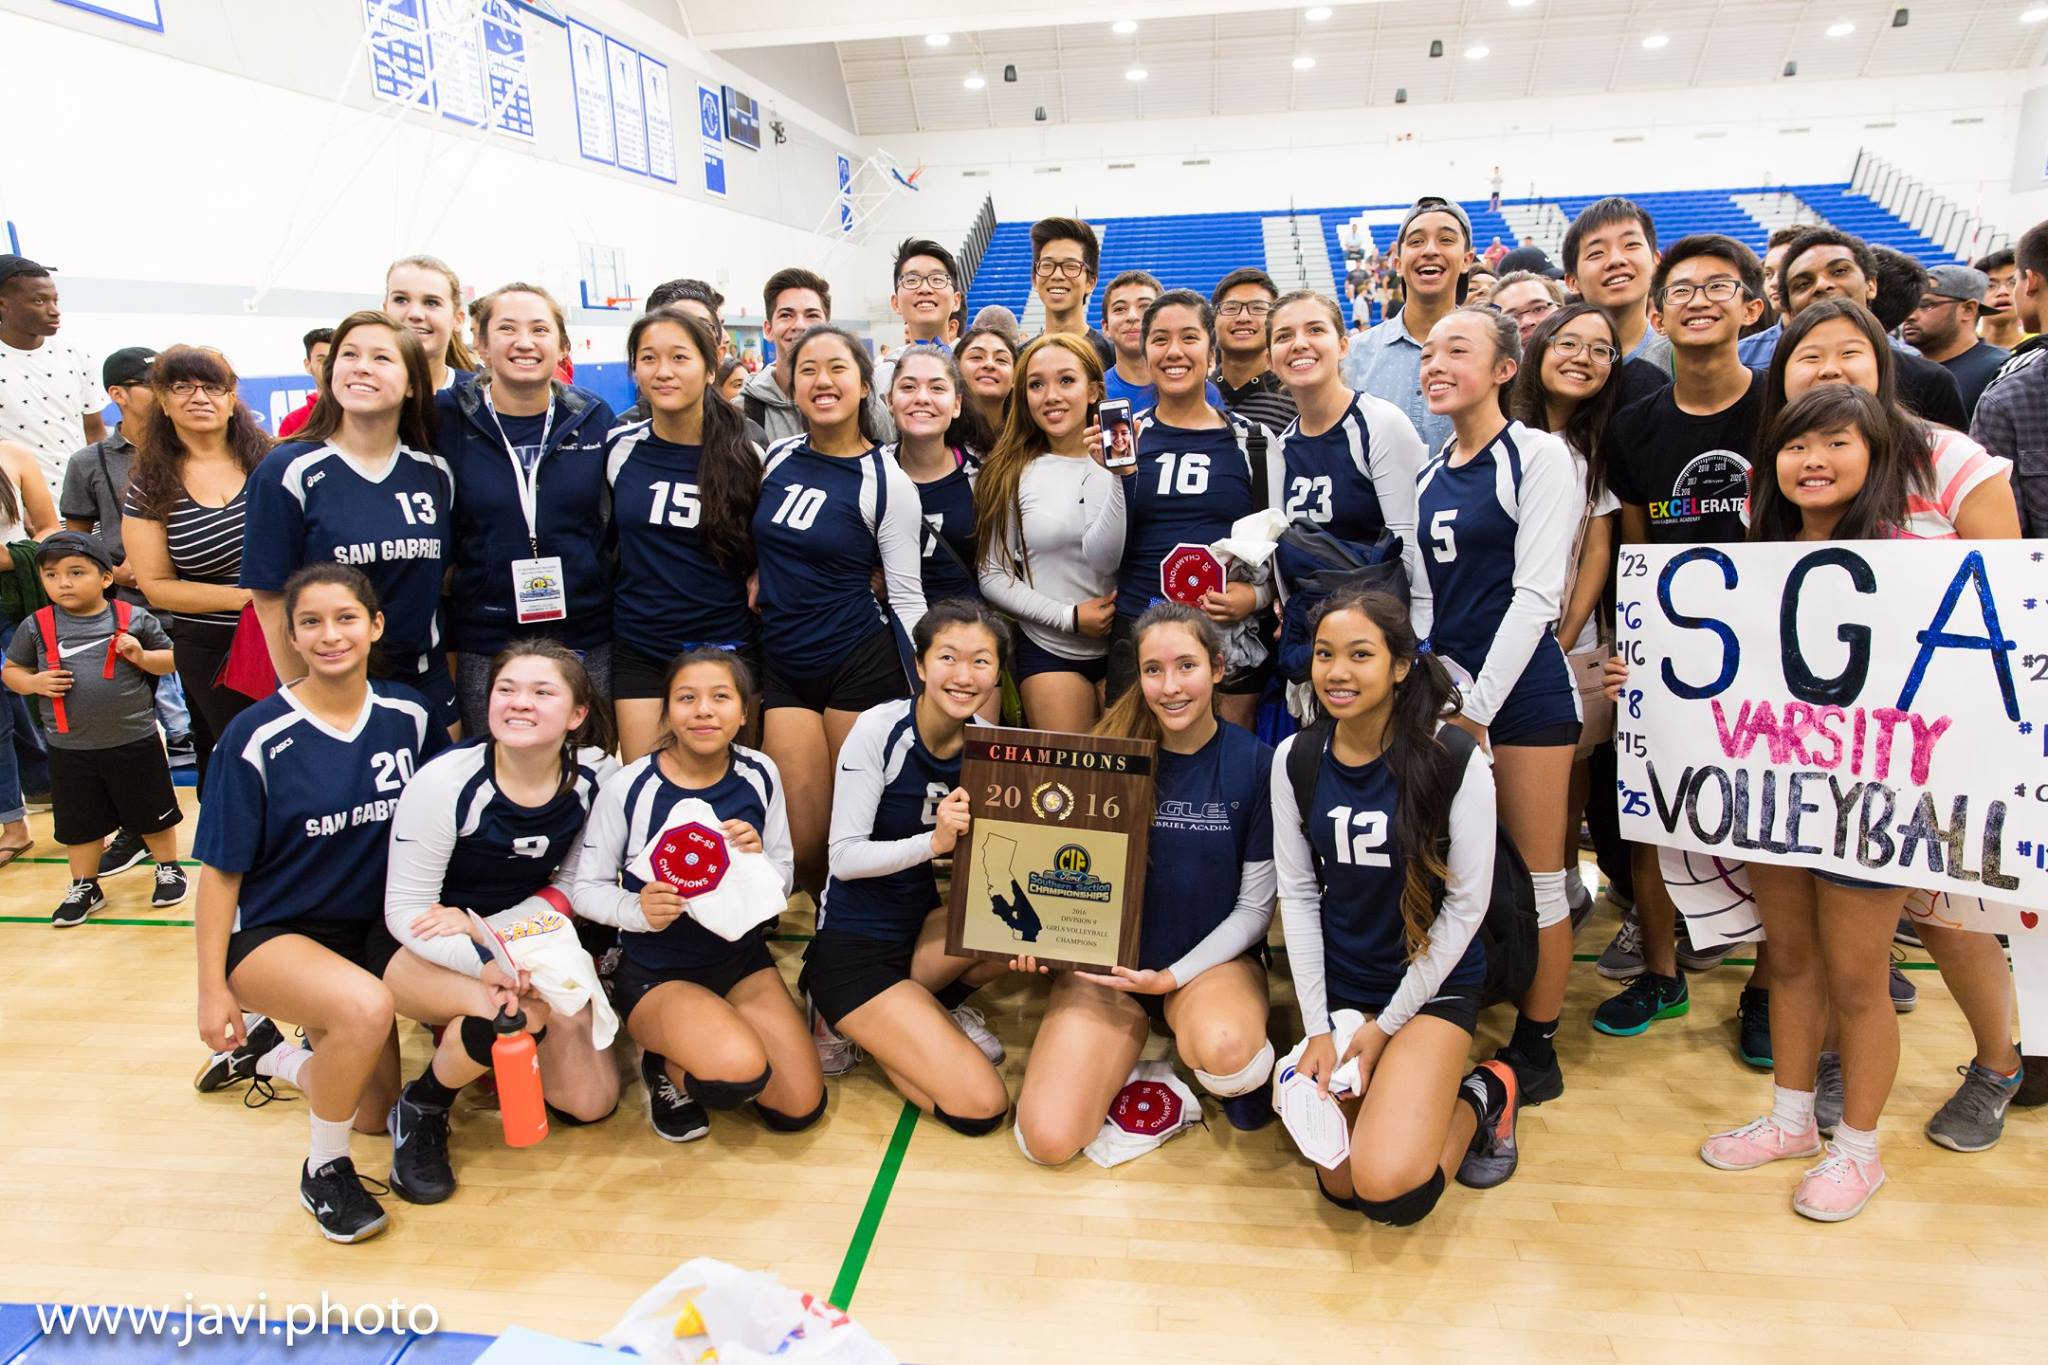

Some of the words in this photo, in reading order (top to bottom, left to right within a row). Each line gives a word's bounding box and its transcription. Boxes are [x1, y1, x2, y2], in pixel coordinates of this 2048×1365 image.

[1155, 453, 1212, 495] 16
[394, 491, 437, 525] 13
[648, 480, 701, 528] 15
[772, 483, 828, 530] 10
[1287, 475, 1333, 523] 23
[333, 542, 376, 565] SAN
[381, 538, 441, 560] GABRIEL
[1430, 508, 1459, 563] 5
[1169, 554, 1201, 588] CHAMPIONS
[1616, 601, 1643, 629] #6
[1617, 687, 1644, 719] #8
[988, 745, 1127, 771] CHAMPIONS
[1711, 699, 1953, 787] VARSITY
[370, 747, 415, 792] 20
[984, 784, 1022, 809] 20
[1084, 793, 1121, 819] 16
[305, 811, 348, 837] SAN
[1327, 805, 1392, 868] 12
[1645, 760, 2020, 892] VOLLEYBALL
[664, 842, 676, 853] 20
[1058, 848, 1087, 872] CIF
[659, 858, 709, 888] CHAMPIONS
[707, 864, 717, 874] 16
[1030, 873, 1072, 890] Southern
[1076, 882, 1111, 892] Section
[1029, 883, 1110, 901] CHAMPIONSHIPS
